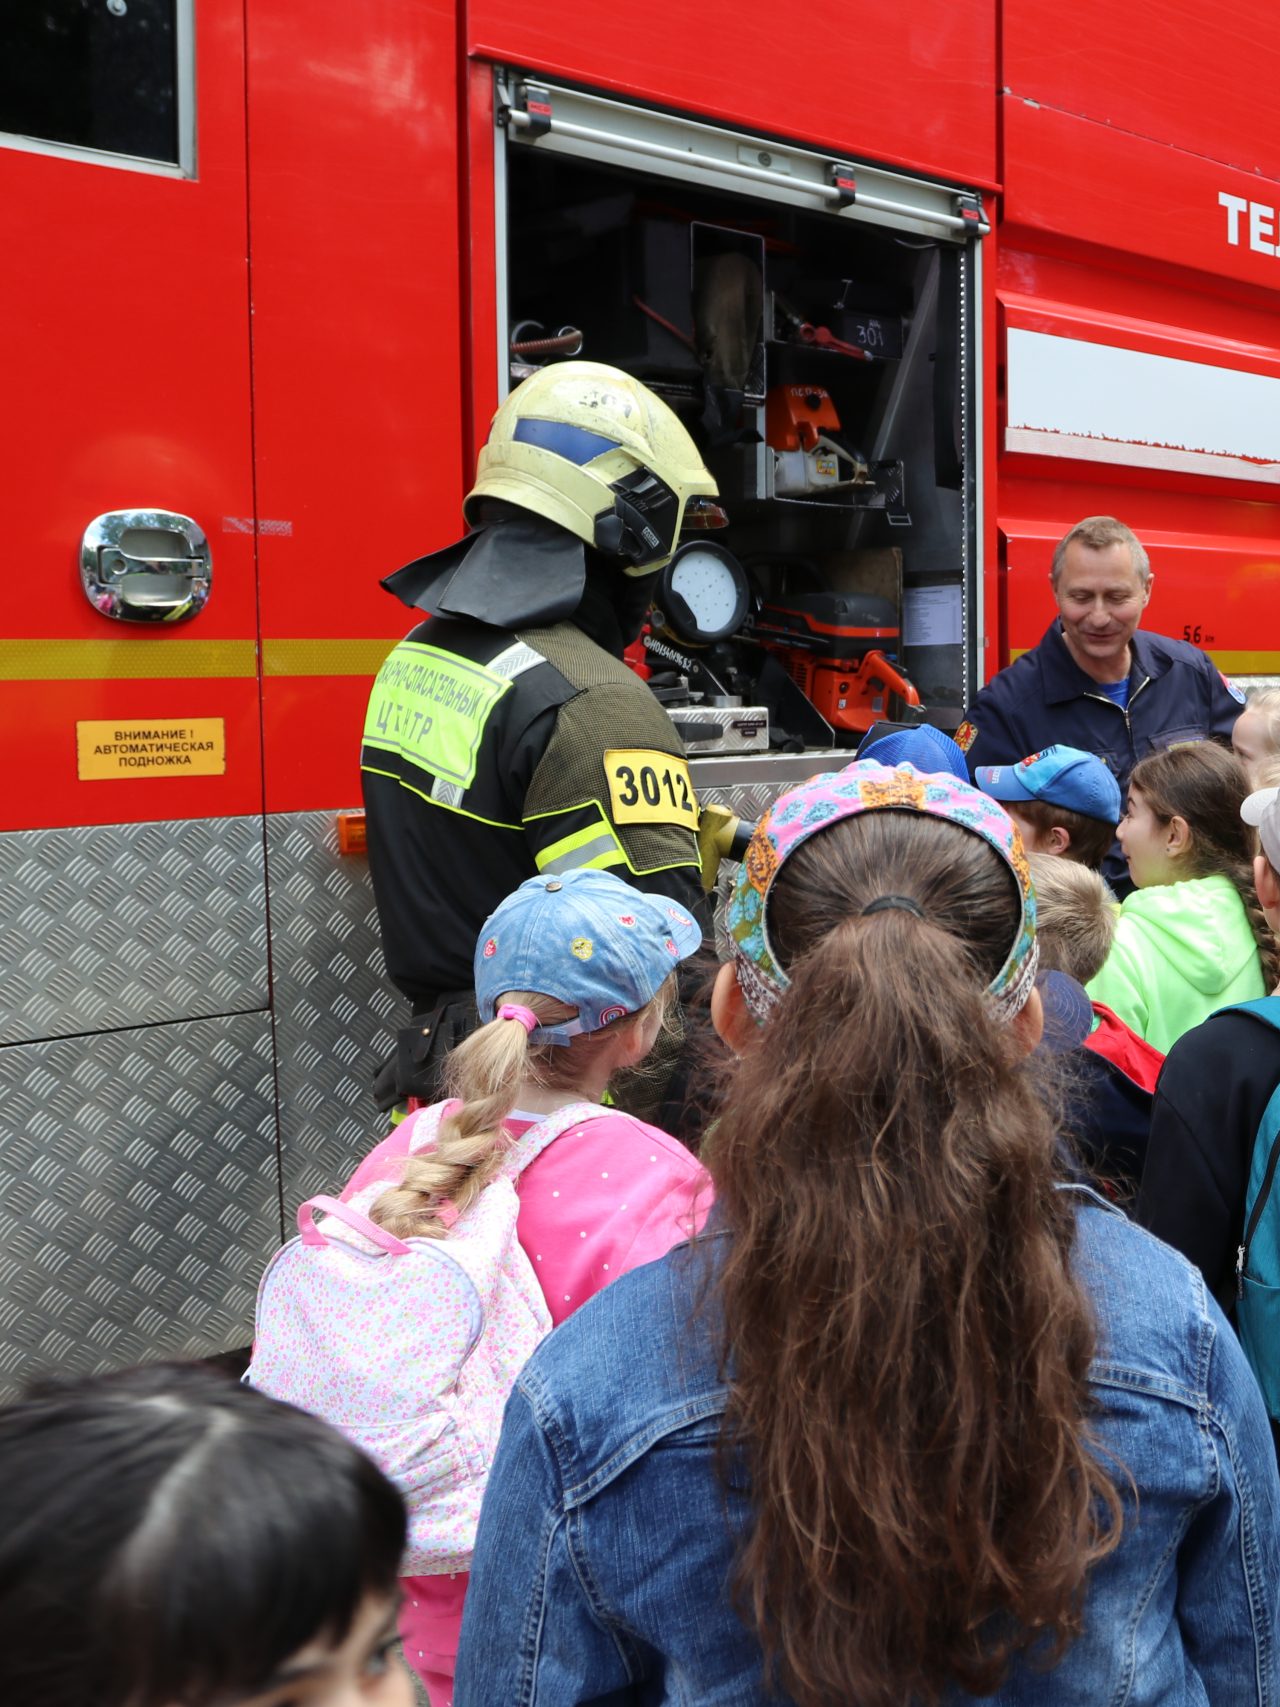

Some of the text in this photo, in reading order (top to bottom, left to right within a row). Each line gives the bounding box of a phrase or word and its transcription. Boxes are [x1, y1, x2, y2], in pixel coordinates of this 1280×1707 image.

[856, 325, 884, 347] 301
[114, 729, 187, 741] ВНИМАНИЕ
[94, 741, 214, 755] АВТОМАТИЧЕСКАЯ
[119, 754, 192, 767] ПОДНОЖКА
[615, 765, 694, 813] 3012
